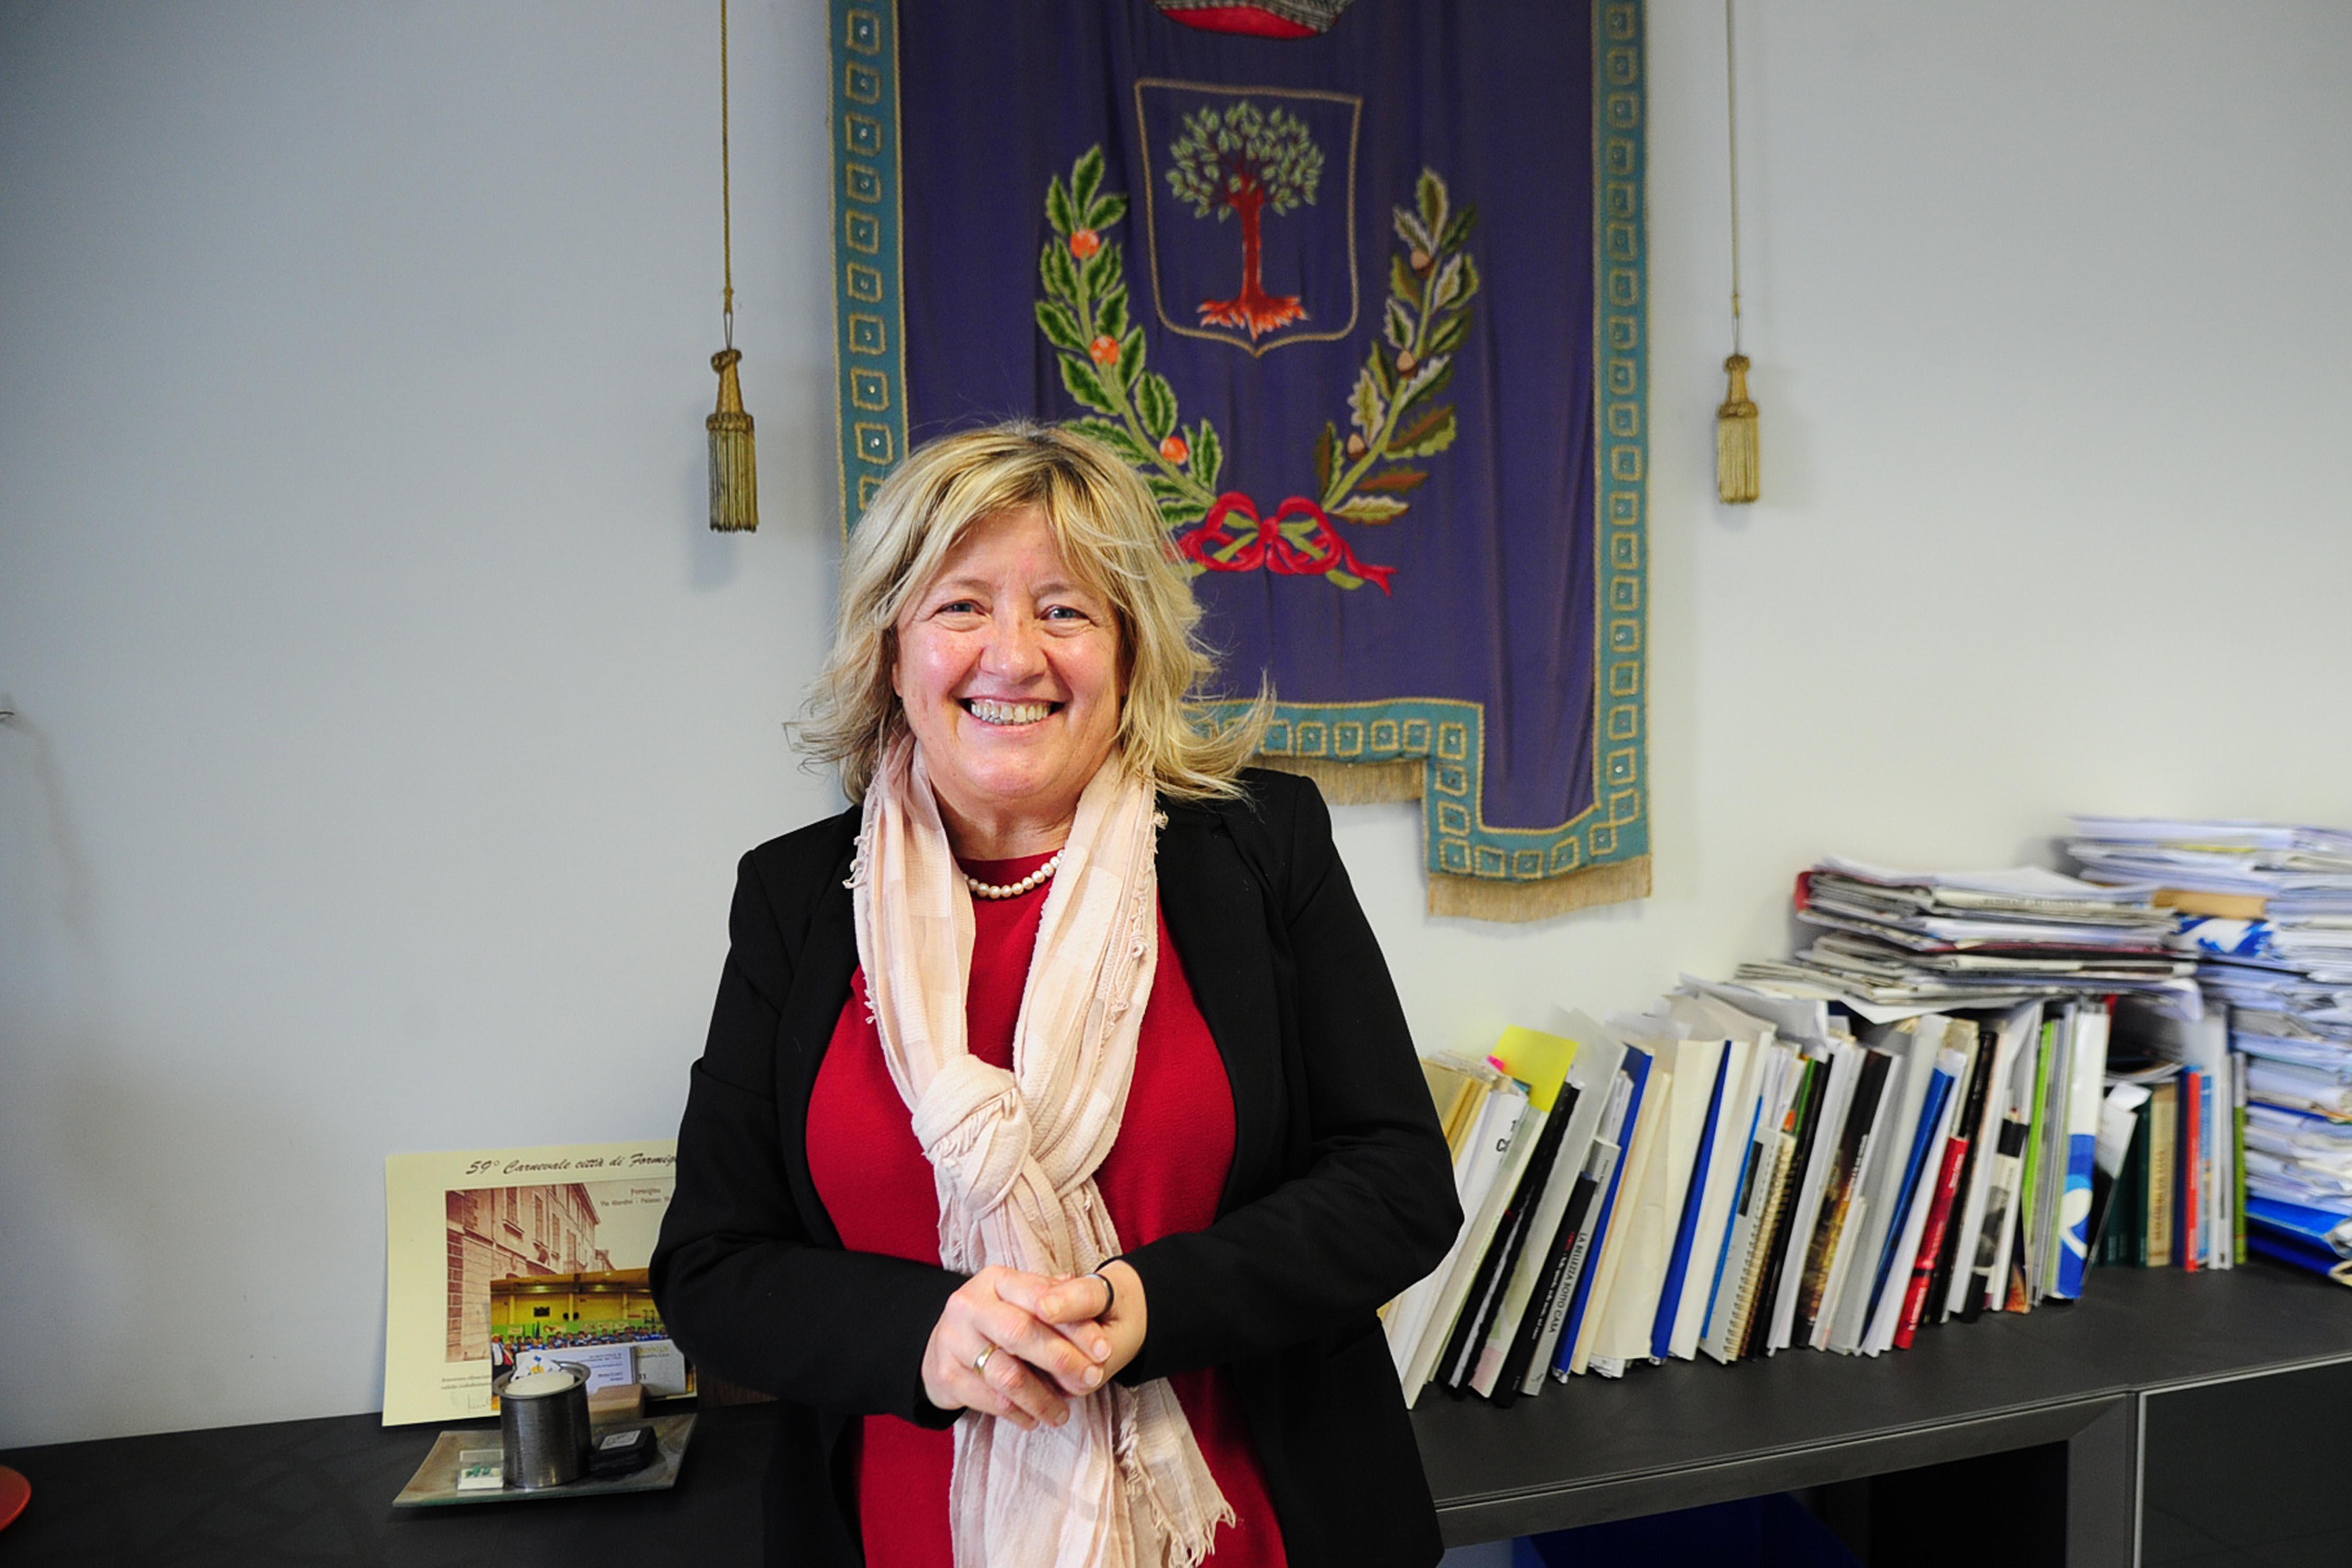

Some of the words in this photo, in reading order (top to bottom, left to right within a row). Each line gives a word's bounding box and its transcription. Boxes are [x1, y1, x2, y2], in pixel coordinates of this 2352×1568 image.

[466, 1159, 500, 1174] 59°
[503, 1158, 571, 1174] Carnevale
[575, 1158, 604, 1170] città
[609, 1155, 625, 1166] di
[629, 1152, 676, 1167] Formig
[1577, 1232, 1588, 1243] LA
[1566, 1245, 1584, 1280] BELLEZZA
[1557, 1282, 1571, 1309] SOTTO
[1549, 1310, 1562, 1333] CASA
